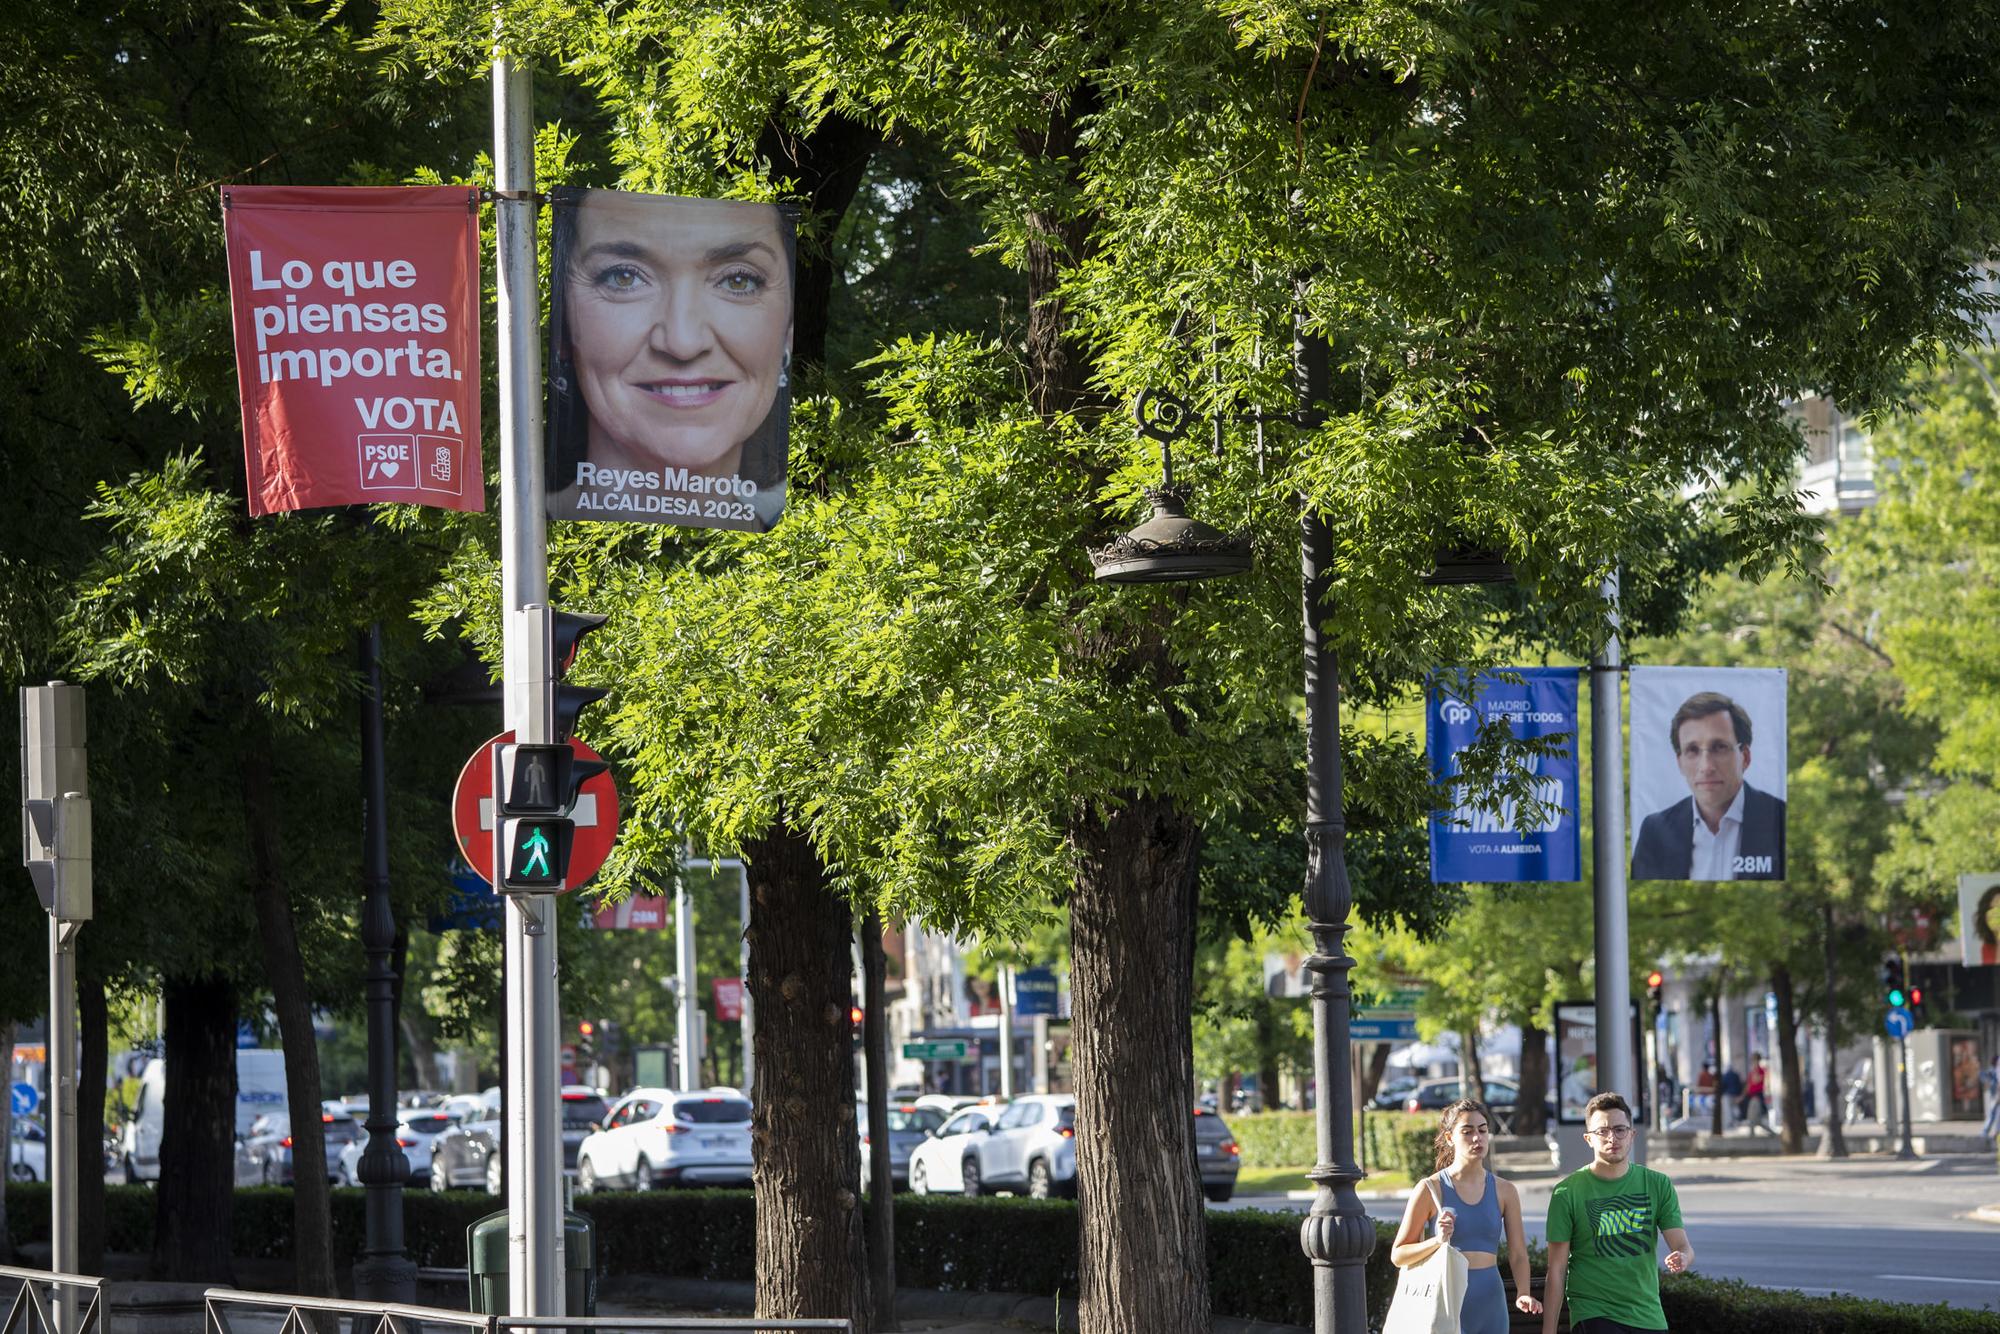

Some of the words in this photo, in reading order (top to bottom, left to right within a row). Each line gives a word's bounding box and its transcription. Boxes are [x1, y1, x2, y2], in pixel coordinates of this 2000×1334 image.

[250, 250, 313, 290] Lo
[322, 259, 417, 297] que
[254, 294, 448, 351] piensas
[259, 340, 462, 386] importa.
[354, 397, 462, 434] VOTA
[365, 445, 409, 460] PSOE
[576, 462, 660, 492] Reyes
[664, 467, 757, 498] Maroto
[576, 493, 700, 517] ALCALDESA
[703, 501, 756, 521] 2023
[1488, 700, 1531, 712] MADRID
[1488, 712, 1524, 723] ENRE
[1525, 713, 1563, 723] TODOS
[1469, 844, 1493, 854] VOTA
[1493, 845, 1500, 854] A
[1501, 844, 1542, 854] ALMEIDA
[1733, 855, 1772, 873] 28M
[1598, 1207, 1647, 1236] NIKE
